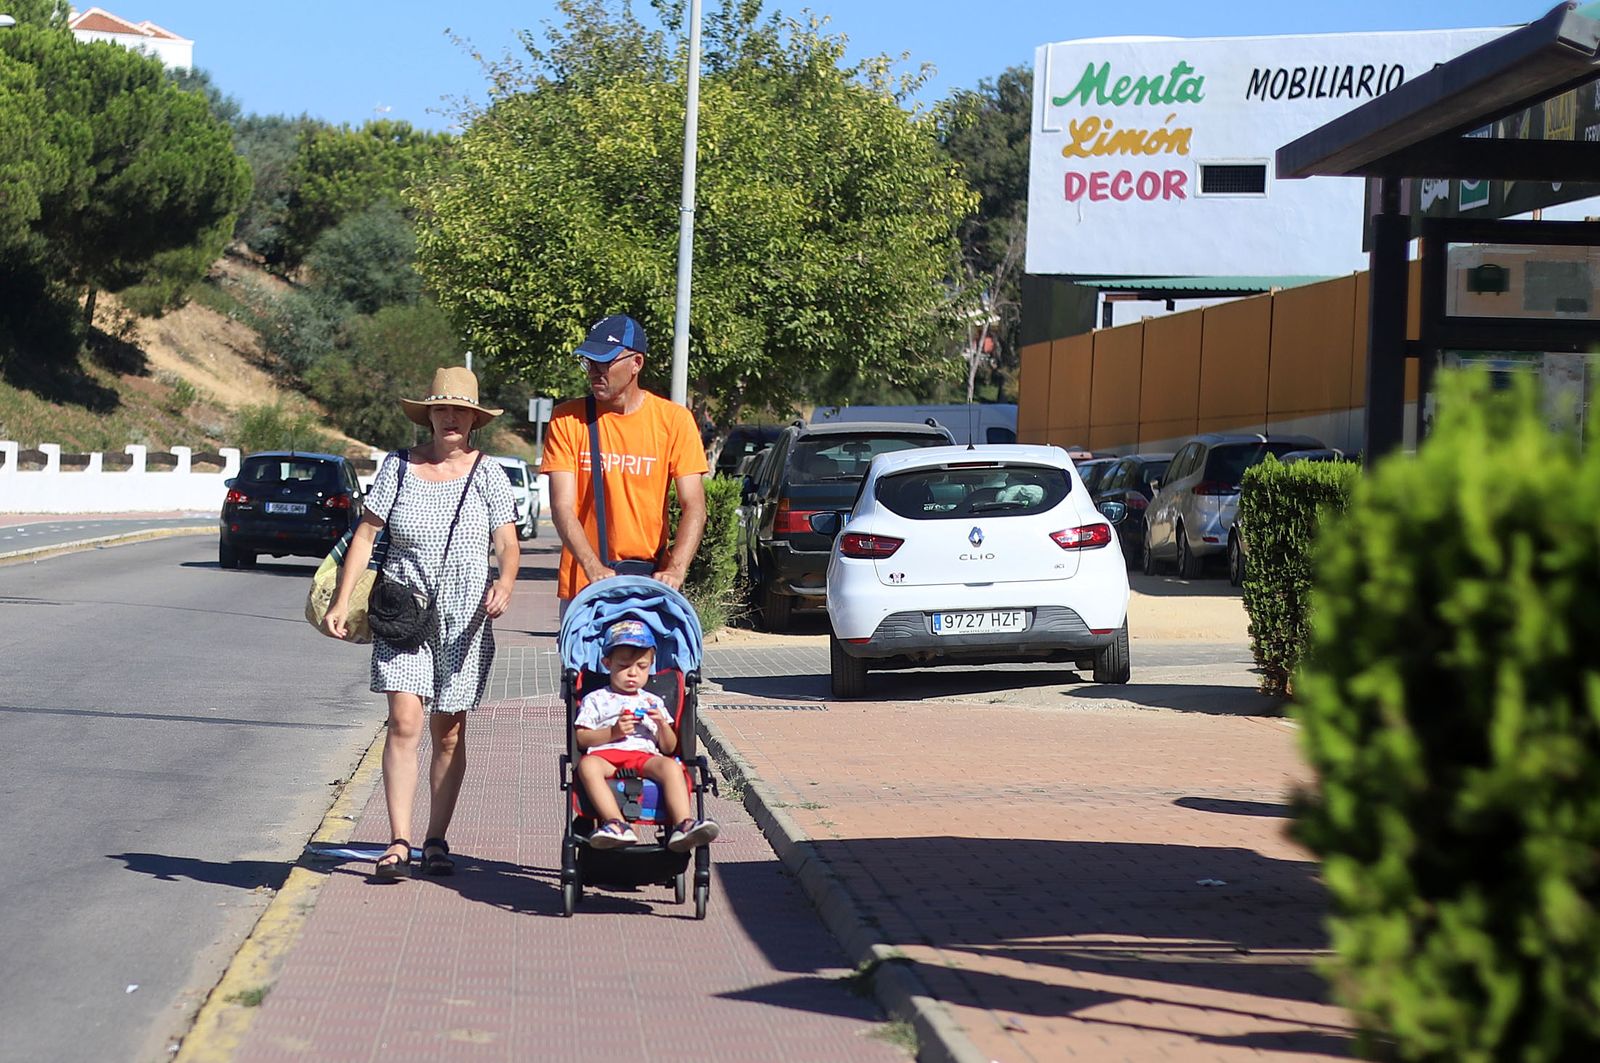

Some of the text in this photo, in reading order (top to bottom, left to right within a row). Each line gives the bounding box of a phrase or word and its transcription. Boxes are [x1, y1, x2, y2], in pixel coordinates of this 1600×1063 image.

[1052, 60, 1205, 107] Menta
[1246, 63, 1405, 102] MOBILIARIO
[1062, 113, 1193, 158] Limón
[1064, 169, 1188, 202] DECOR
[959, 553, 995, 561] CLIO
[944, 612, 1021, 629] 9727 HZF
